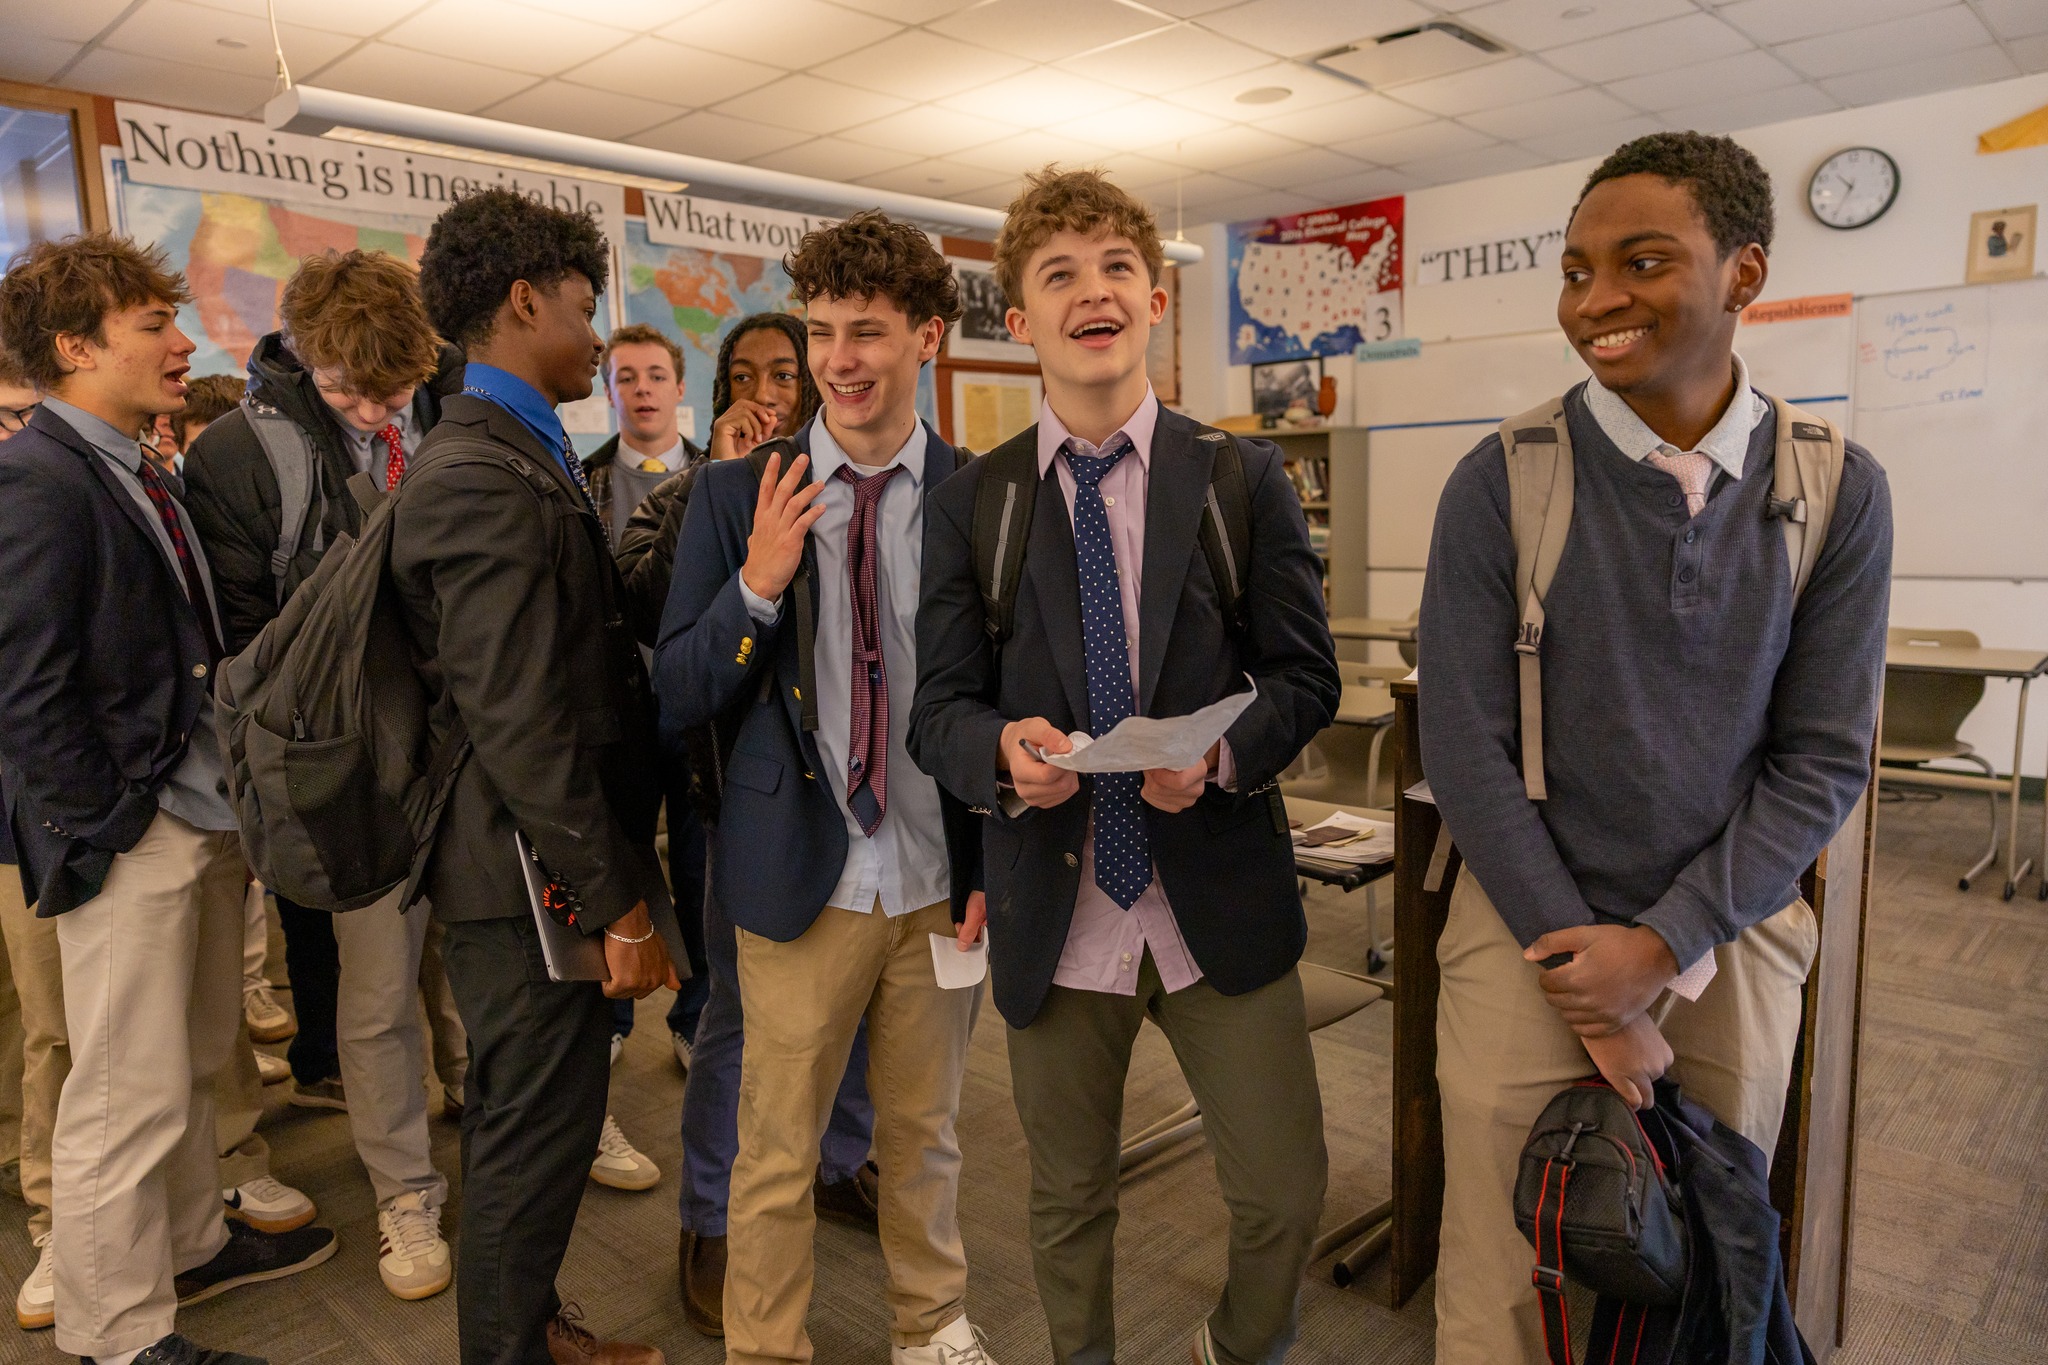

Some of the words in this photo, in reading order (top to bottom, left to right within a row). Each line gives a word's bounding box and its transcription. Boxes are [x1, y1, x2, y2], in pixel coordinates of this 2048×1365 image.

[122, 118, 349, 200] Nothing
[356, 151, 394, 196] is
[404, 157, 604, 224] ineable
[650, 196, 735, 242] What
[1348, 215, 1387, 230] College
[1374, 306, 1391, 341] 3
[1747, 301, 1847, 323] Republicans
[543, 887, 551, 907] NIKE
